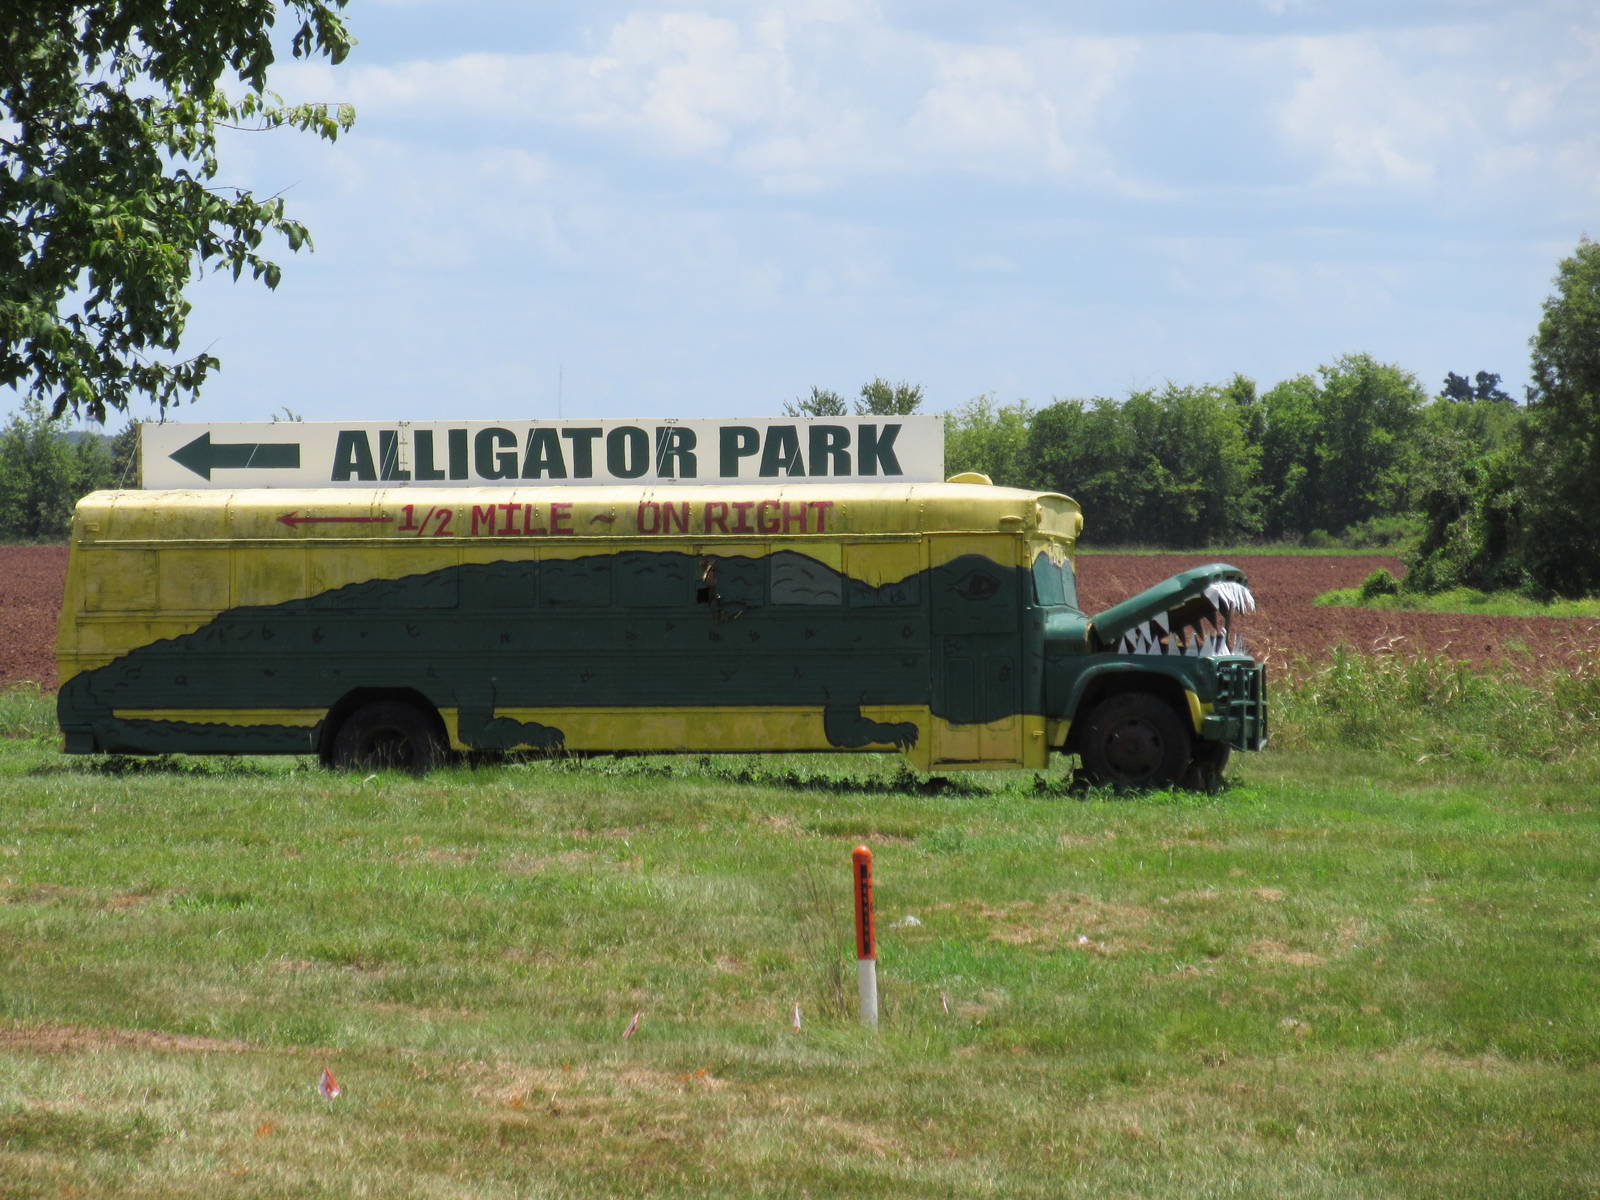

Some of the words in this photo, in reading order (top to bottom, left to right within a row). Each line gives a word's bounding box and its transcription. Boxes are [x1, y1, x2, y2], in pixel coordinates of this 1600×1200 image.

[331, 426, 697, 481] ALLIGATOR
[719, 424, 904, 478] PARK
[399, 504, 454, 536] 1/2
[471, 503, 574, 536] MILE
[637, 502, 690, 535] ON
[704, 501, 834, 535] RIGHT
